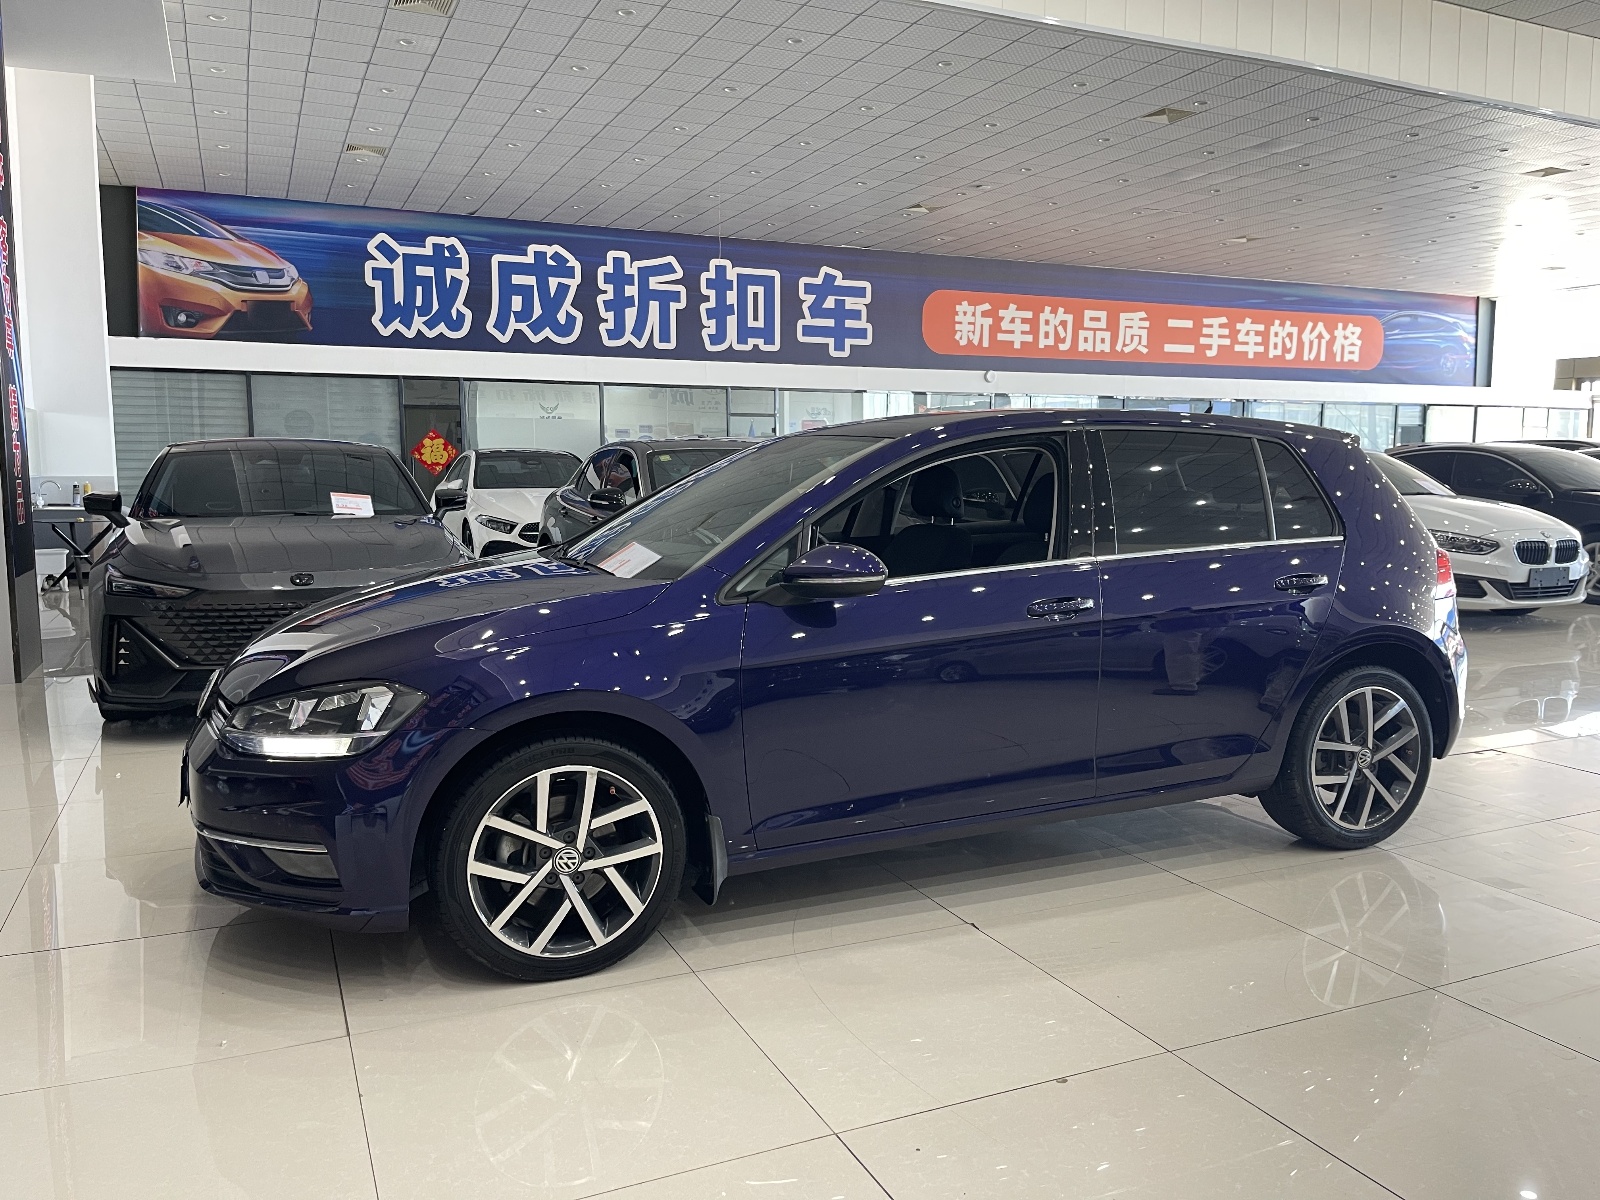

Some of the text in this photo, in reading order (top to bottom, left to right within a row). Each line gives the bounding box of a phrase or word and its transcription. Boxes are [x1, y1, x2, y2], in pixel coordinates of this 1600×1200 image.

[365, 233, 873, 357] 诚成折扣车
[954, 301, 1363, 363] 新车的品质 二手车的价格
[420, 437, 449, 465] 福
